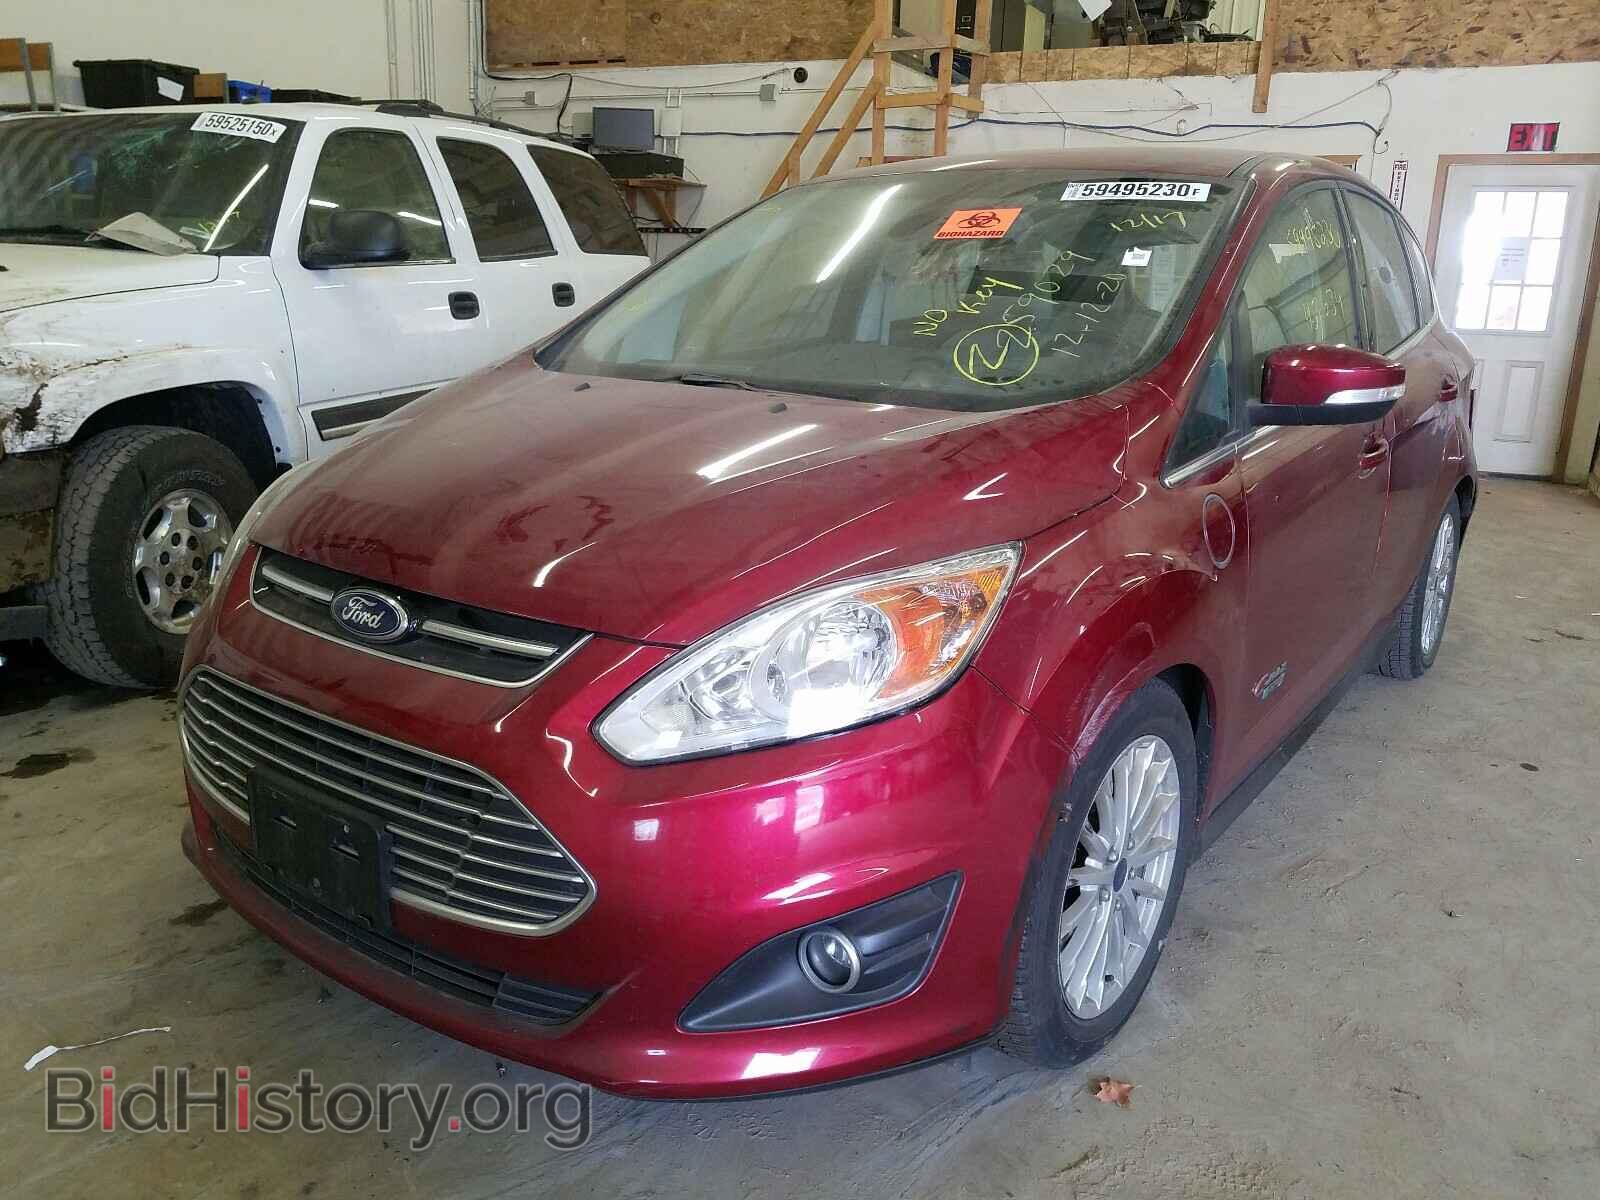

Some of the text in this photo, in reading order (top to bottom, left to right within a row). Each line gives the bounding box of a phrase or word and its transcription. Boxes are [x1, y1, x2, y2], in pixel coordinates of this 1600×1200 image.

[1509, 124, 1557, 149] EXIT
[1394, 163, 1407, 171] FIRE
[937, 230, 1005, 238] BIOHAZARD
[342, 596, 386, 629] Ford
